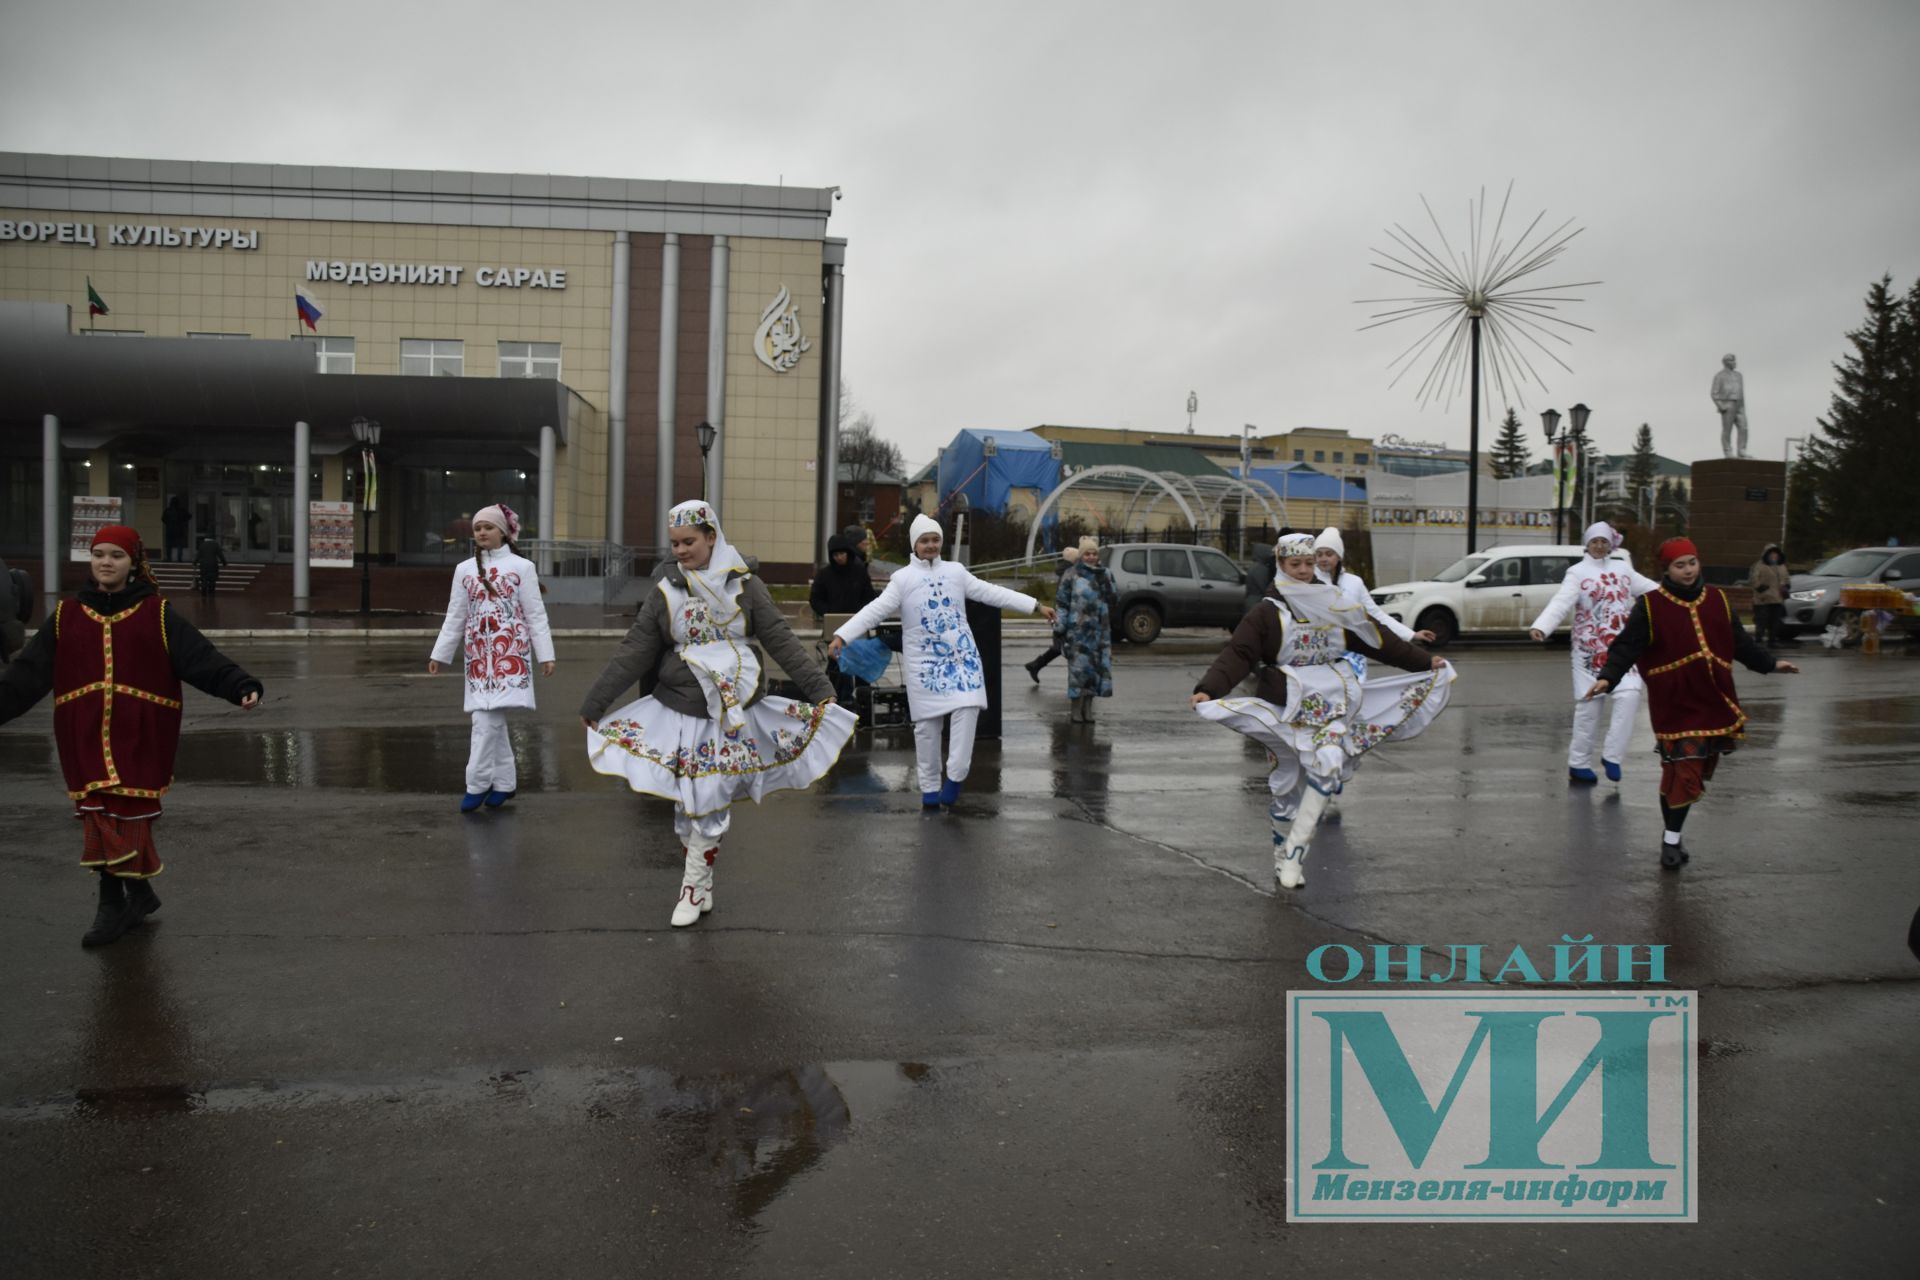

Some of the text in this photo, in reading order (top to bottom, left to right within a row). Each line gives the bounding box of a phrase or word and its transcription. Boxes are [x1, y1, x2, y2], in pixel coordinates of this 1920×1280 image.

[108, 224, 259, 249] КУЛЬТУРЫ
[306, 260, 567, 289] МӘДӘНИЯТ САРАЕ
